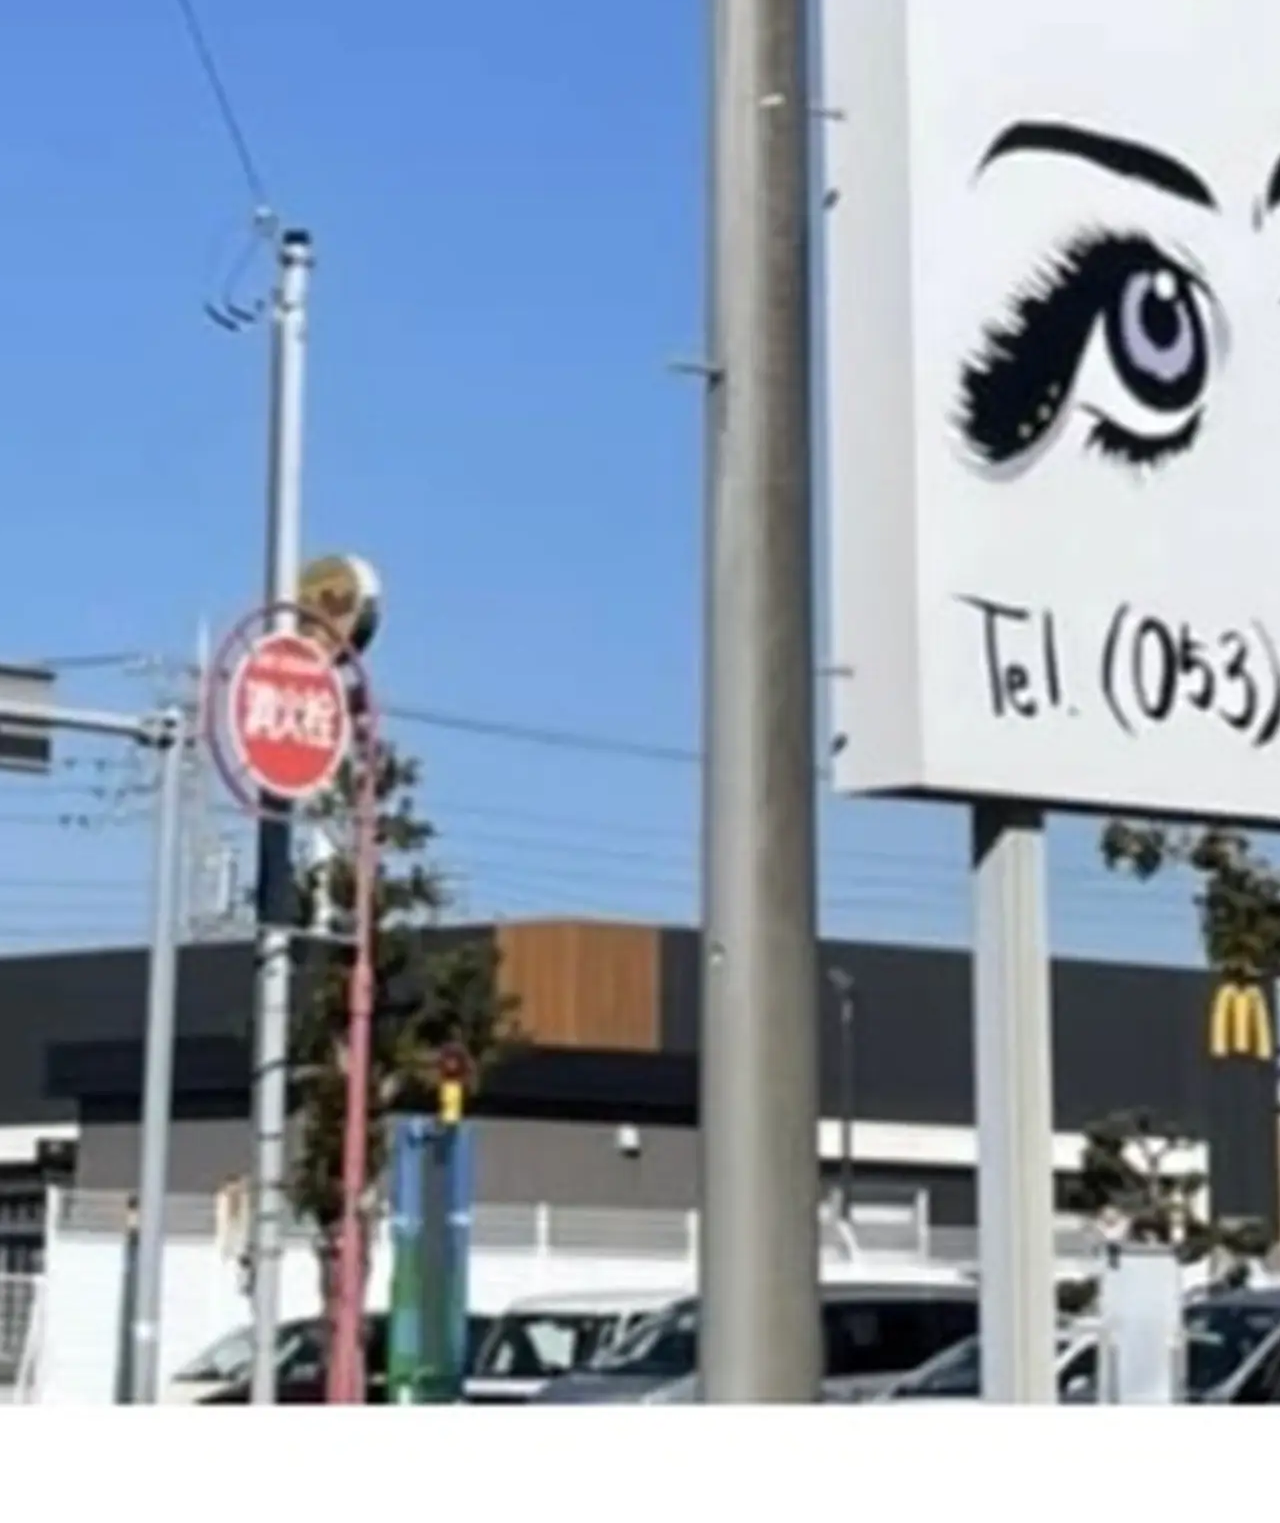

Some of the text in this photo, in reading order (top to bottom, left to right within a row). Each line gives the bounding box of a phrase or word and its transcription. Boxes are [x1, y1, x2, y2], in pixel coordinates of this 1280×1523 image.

[953, 591, 1080, 718] Tel.
[246, 677, 338, 749] 消火栓
